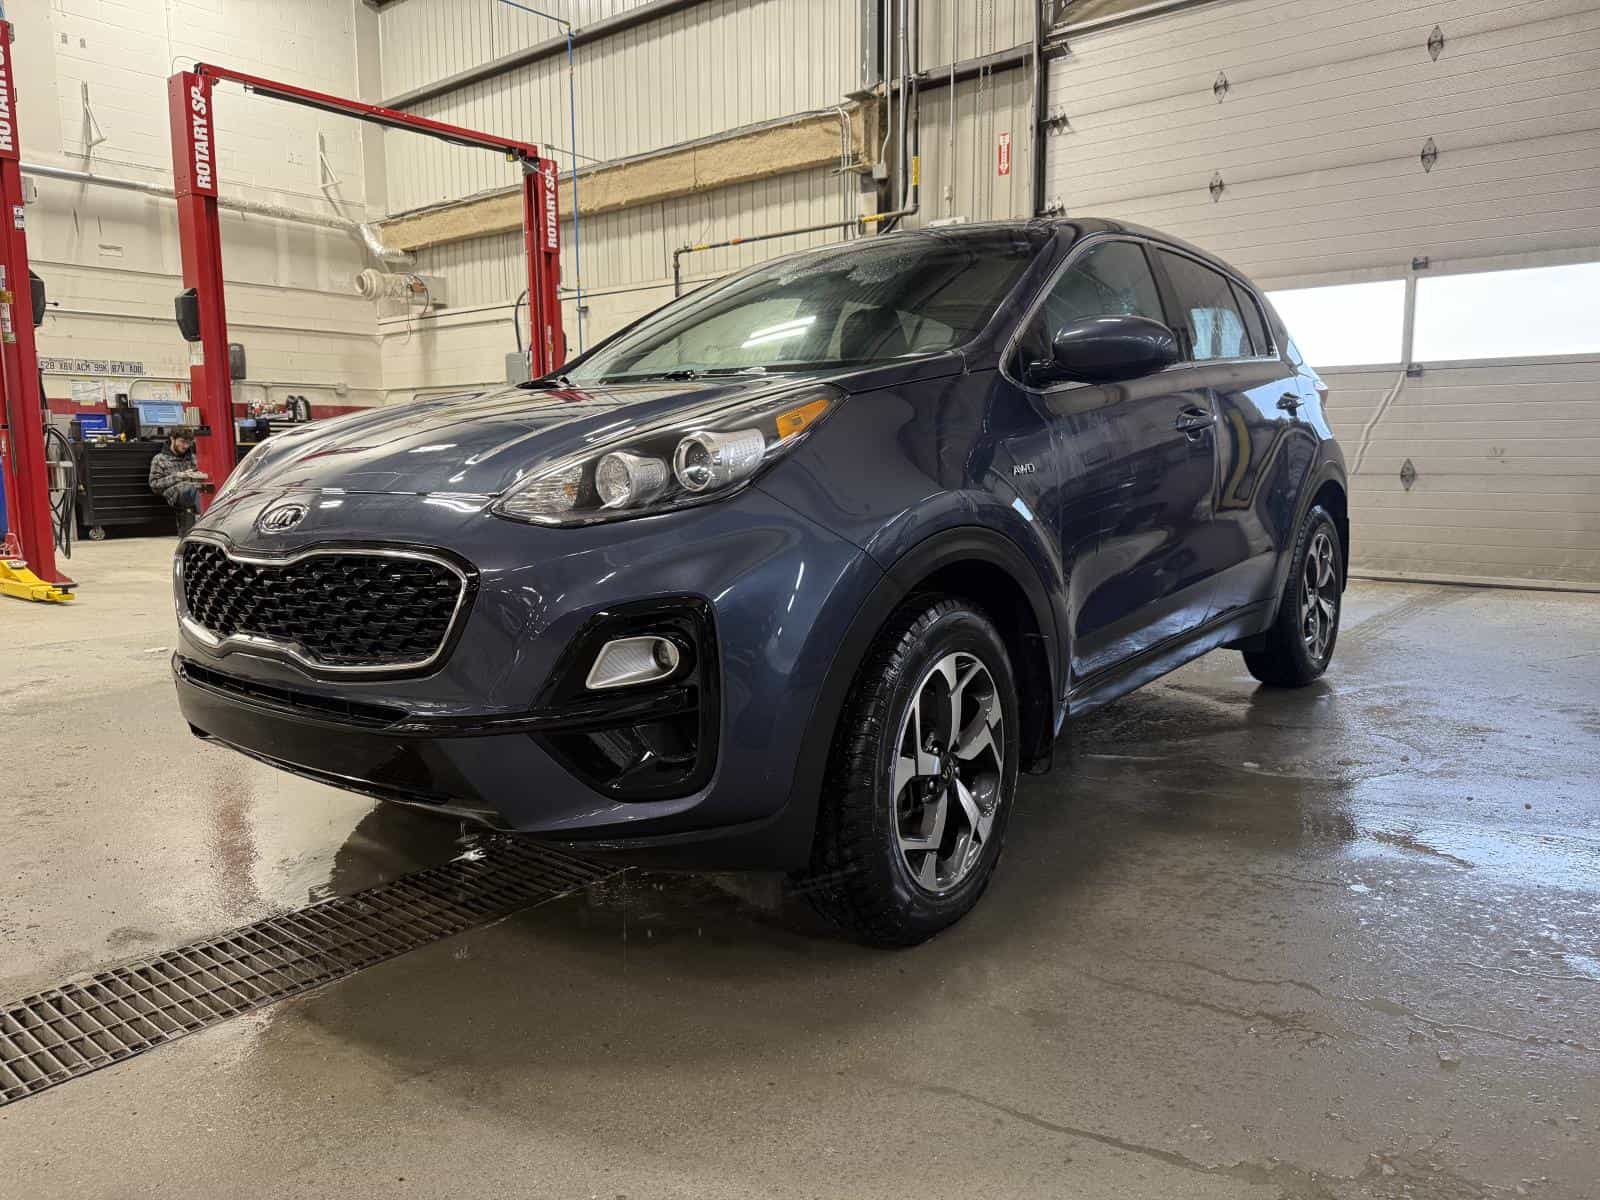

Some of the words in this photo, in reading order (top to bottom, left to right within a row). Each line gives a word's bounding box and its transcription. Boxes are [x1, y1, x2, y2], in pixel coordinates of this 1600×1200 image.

[0, 68, 13, 151] ROTA
[193, 115, 212, 189] ROTARY
[546, 190, 557, 248] ROTARY
[1013, 464, 1035, 476] AWD
[264, 506, 299, 531] KIA
